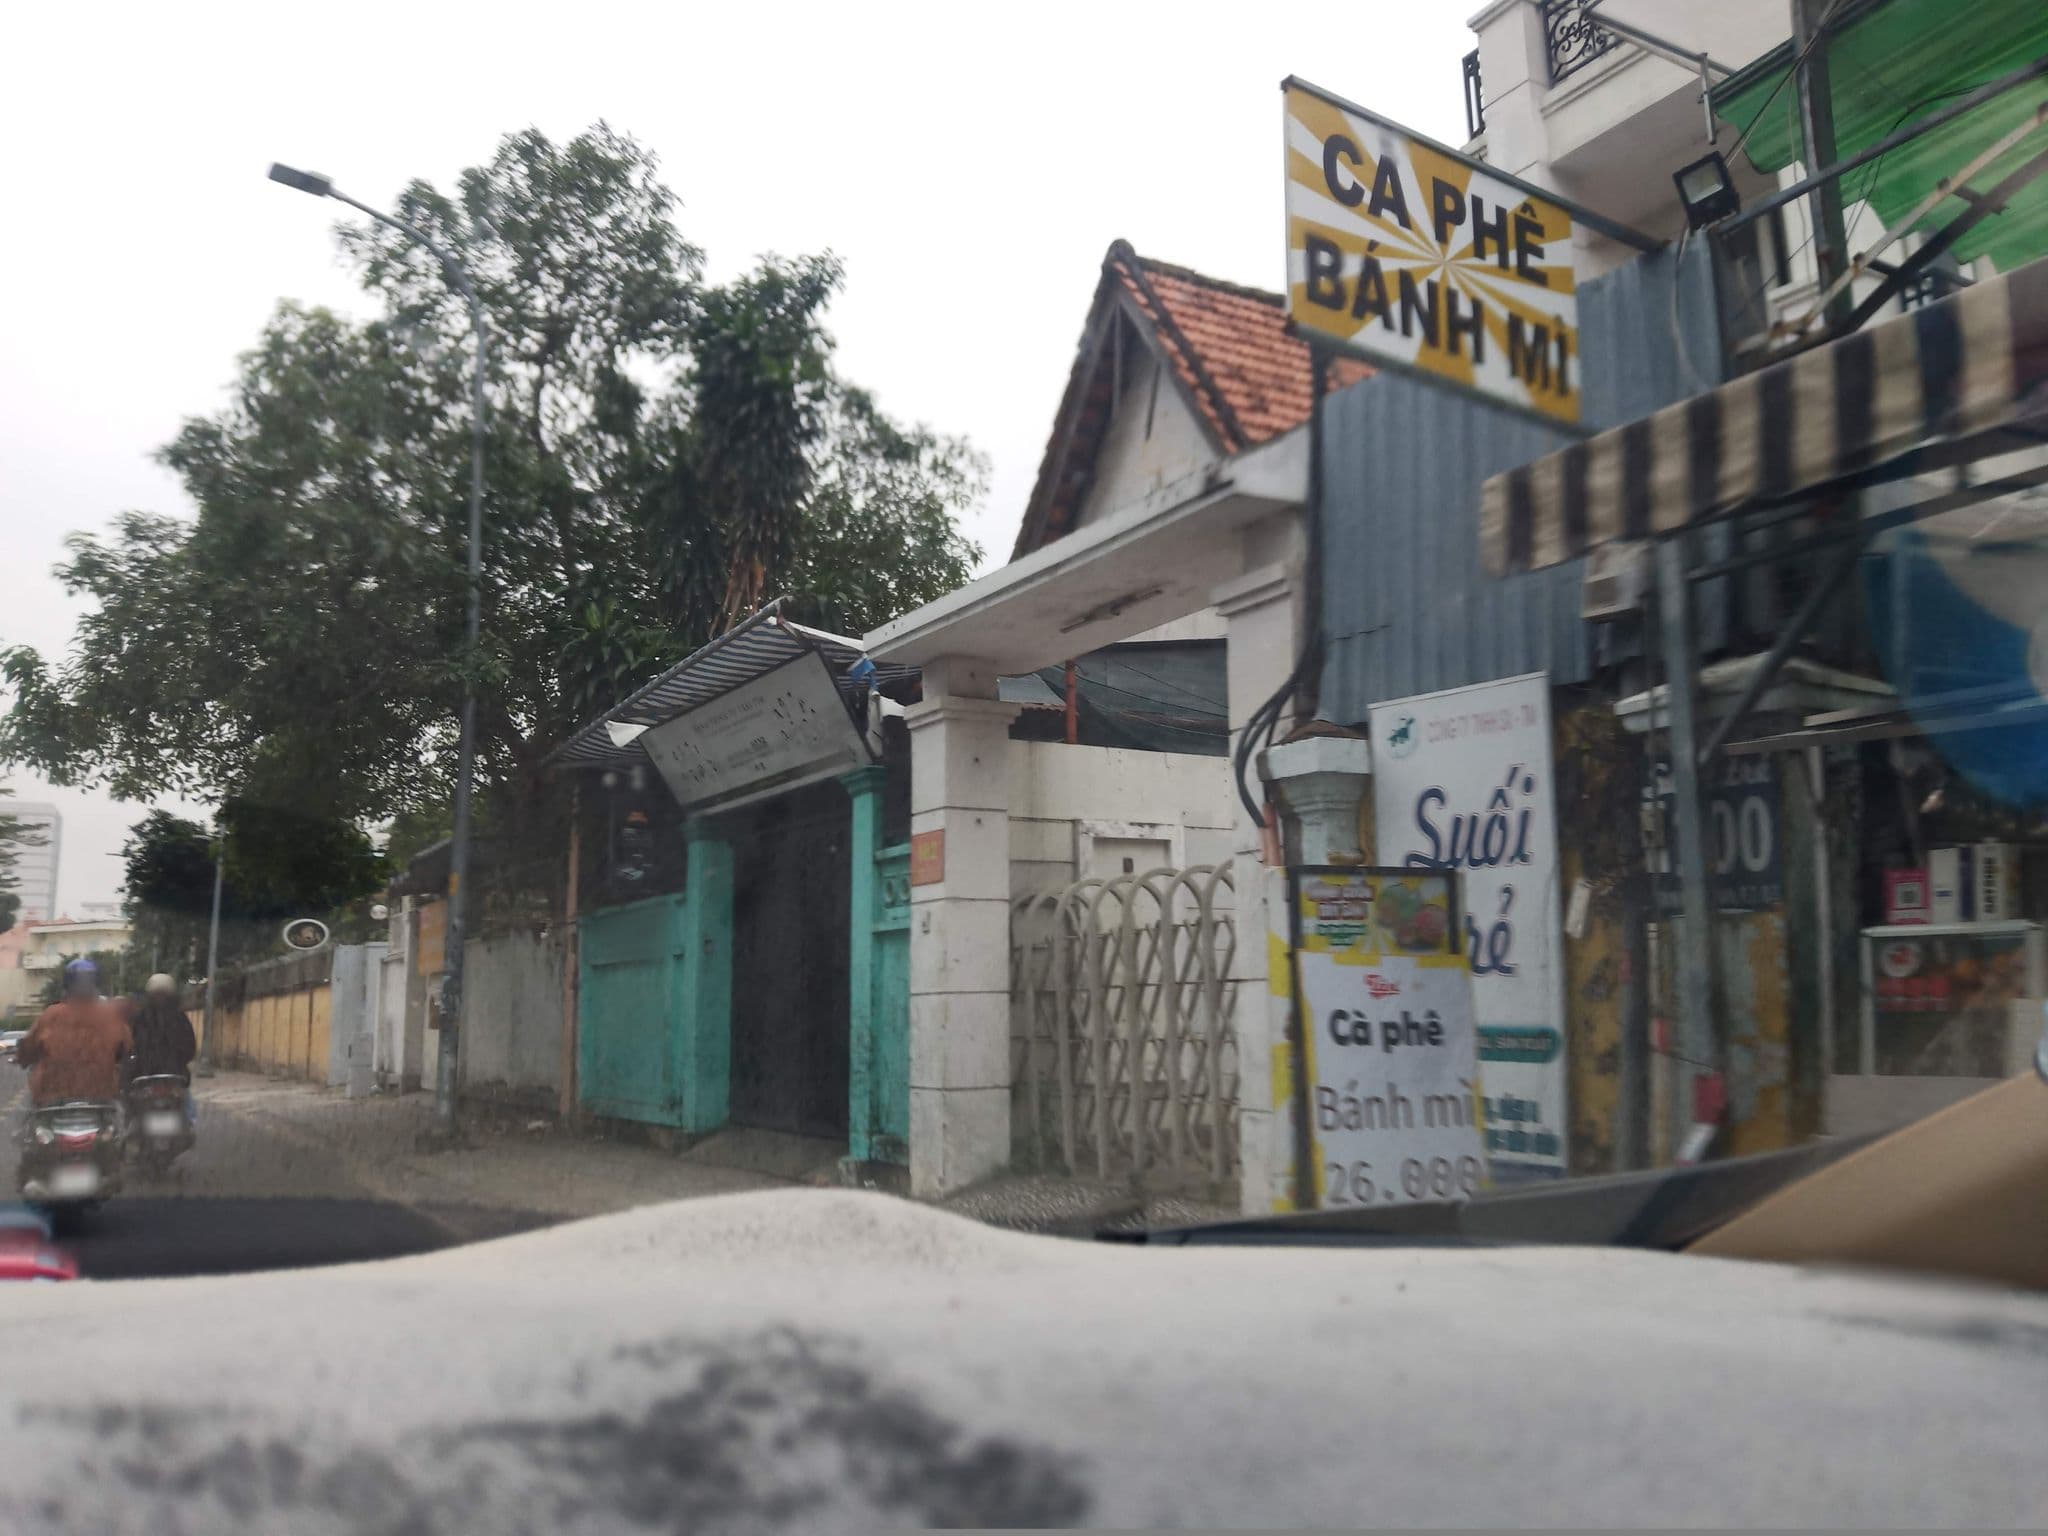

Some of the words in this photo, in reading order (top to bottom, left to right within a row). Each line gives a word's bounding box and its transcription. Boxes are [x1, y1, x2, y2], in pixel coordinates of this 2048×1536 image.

[1433, 176, 1548, 286] PHÊ
[1306, 232, 1484, 363] BÁNH
[1406, 764, 1535, 868] Suối
[1329, 1009, 1371, 1046] Cà
[1380, 1009, 1446, 1053] phê
[1316, 1079, 1415, 1131] Bánh
[1423, 1077, 1475, 1128] mì
